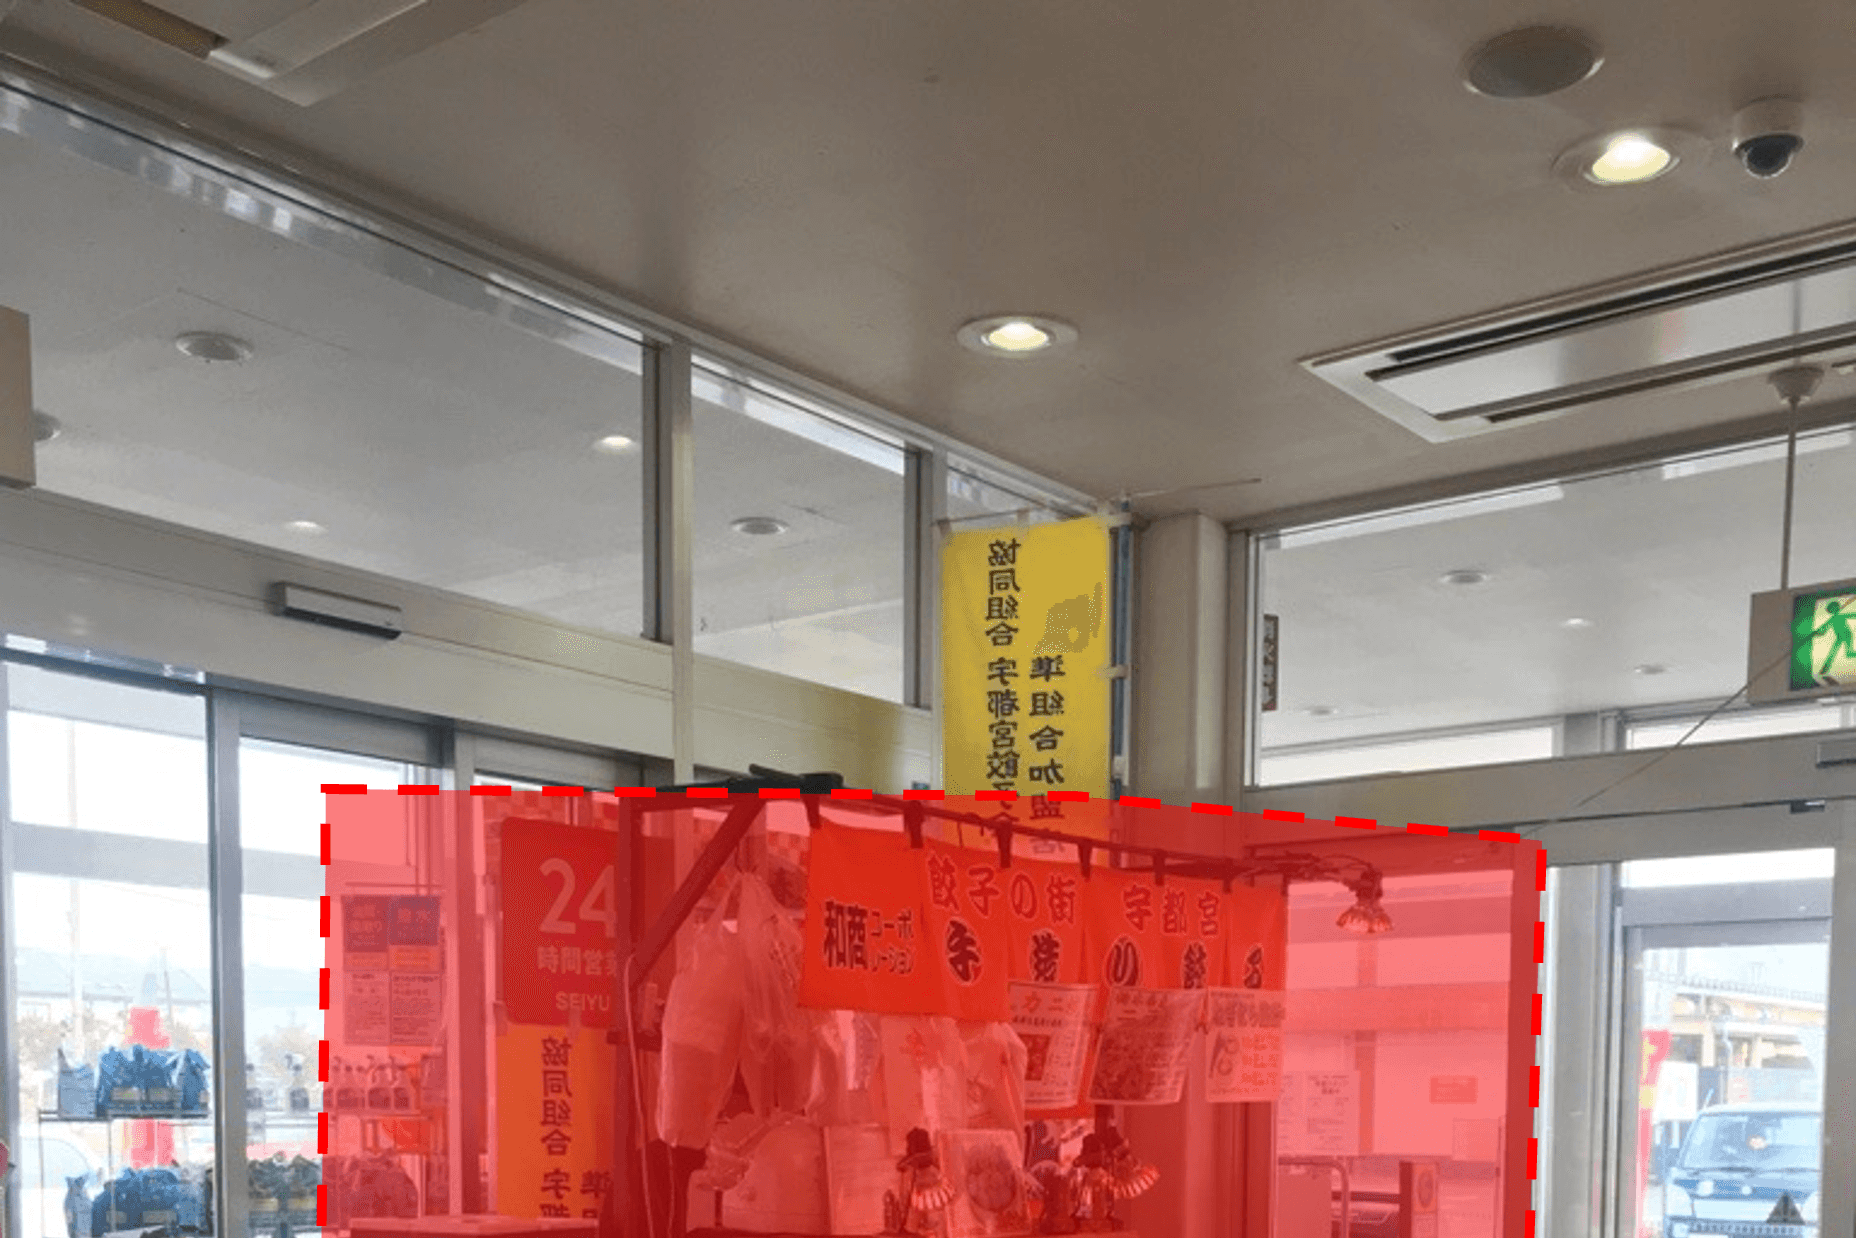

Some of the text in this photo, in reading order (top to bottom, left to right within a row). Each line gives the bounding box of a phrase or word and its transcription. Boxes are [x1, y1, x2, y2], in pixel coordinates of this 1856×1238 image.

[538, 856, 617, 939] 24
[926, 851, 1219, 937] 餃子の街 宇都宮
[554, 990, 611, 1012] SEIYU
